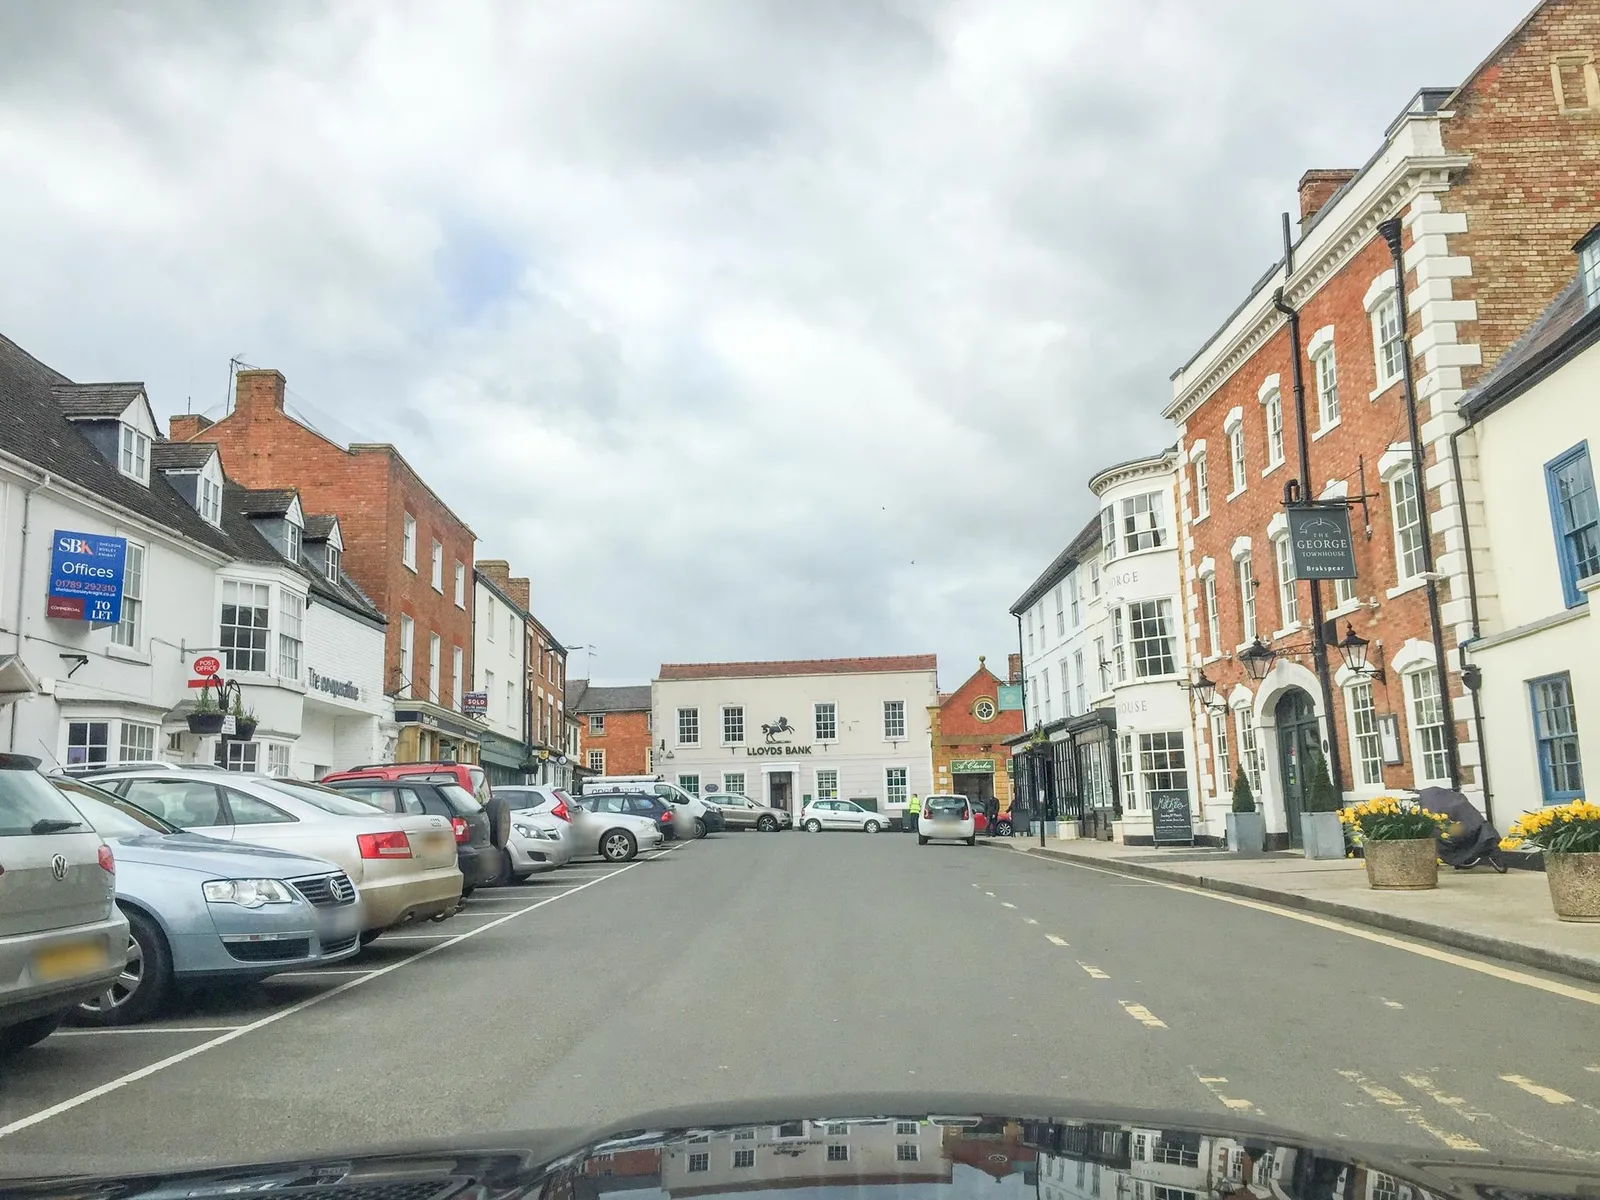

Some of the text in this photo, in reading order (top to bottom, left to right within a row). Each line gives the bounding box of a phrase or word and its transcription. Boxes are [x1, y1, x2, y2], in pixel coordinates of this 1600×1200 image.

[1296, 539, 1348, 549] GEORGE
[62, 561, 114, 578] Offices
[55, 579, 117, 593] 01789 292310
[50, 605, 81, 613] COMMERCIAL
[95, 600, 111, 610] TO
[91, 610, 113, 620] LET
[308, 666, 320, 690] The
[747, 745, 812, 756] LLOYDS BANK
